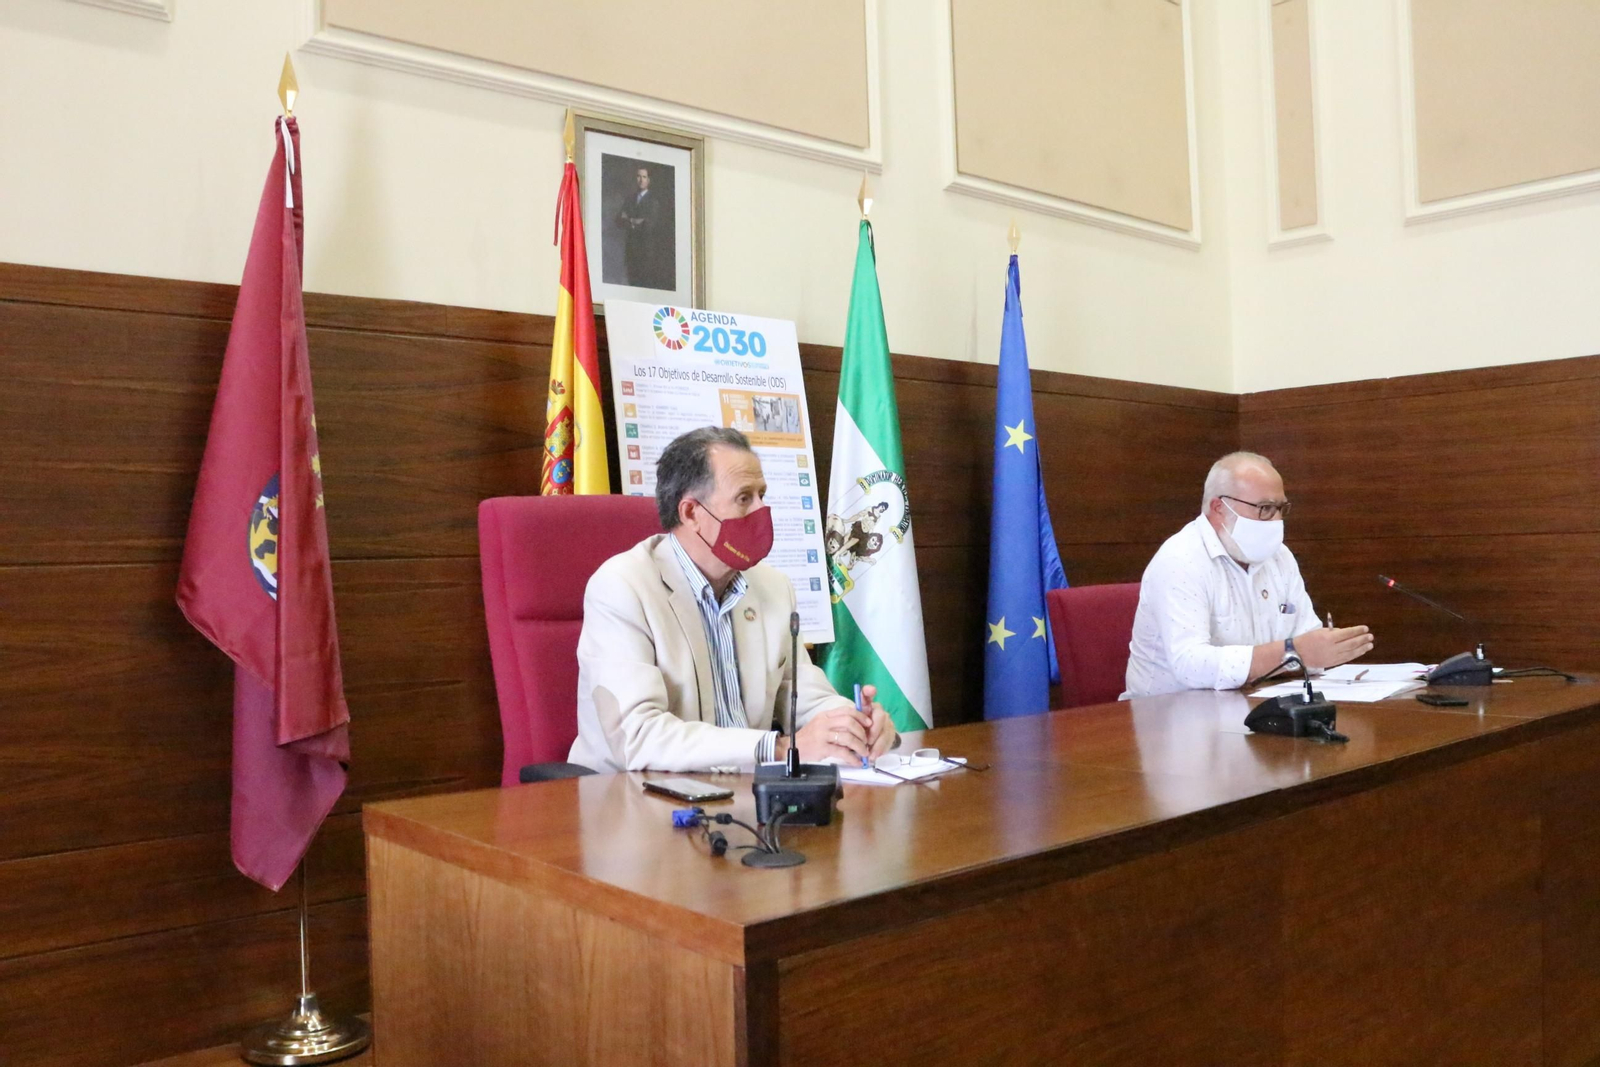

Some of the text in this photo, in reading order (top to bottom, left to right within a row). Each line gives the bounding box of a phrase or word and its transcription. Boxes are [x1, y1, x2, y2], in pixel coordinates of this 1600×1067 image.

[691, 311, 738, 326] AGENDA
[692, 325, 767, 358] 2030
[633, 365, 787, 391] Los 17 Objetivos de Desarrollo Sostenible (ODS)
